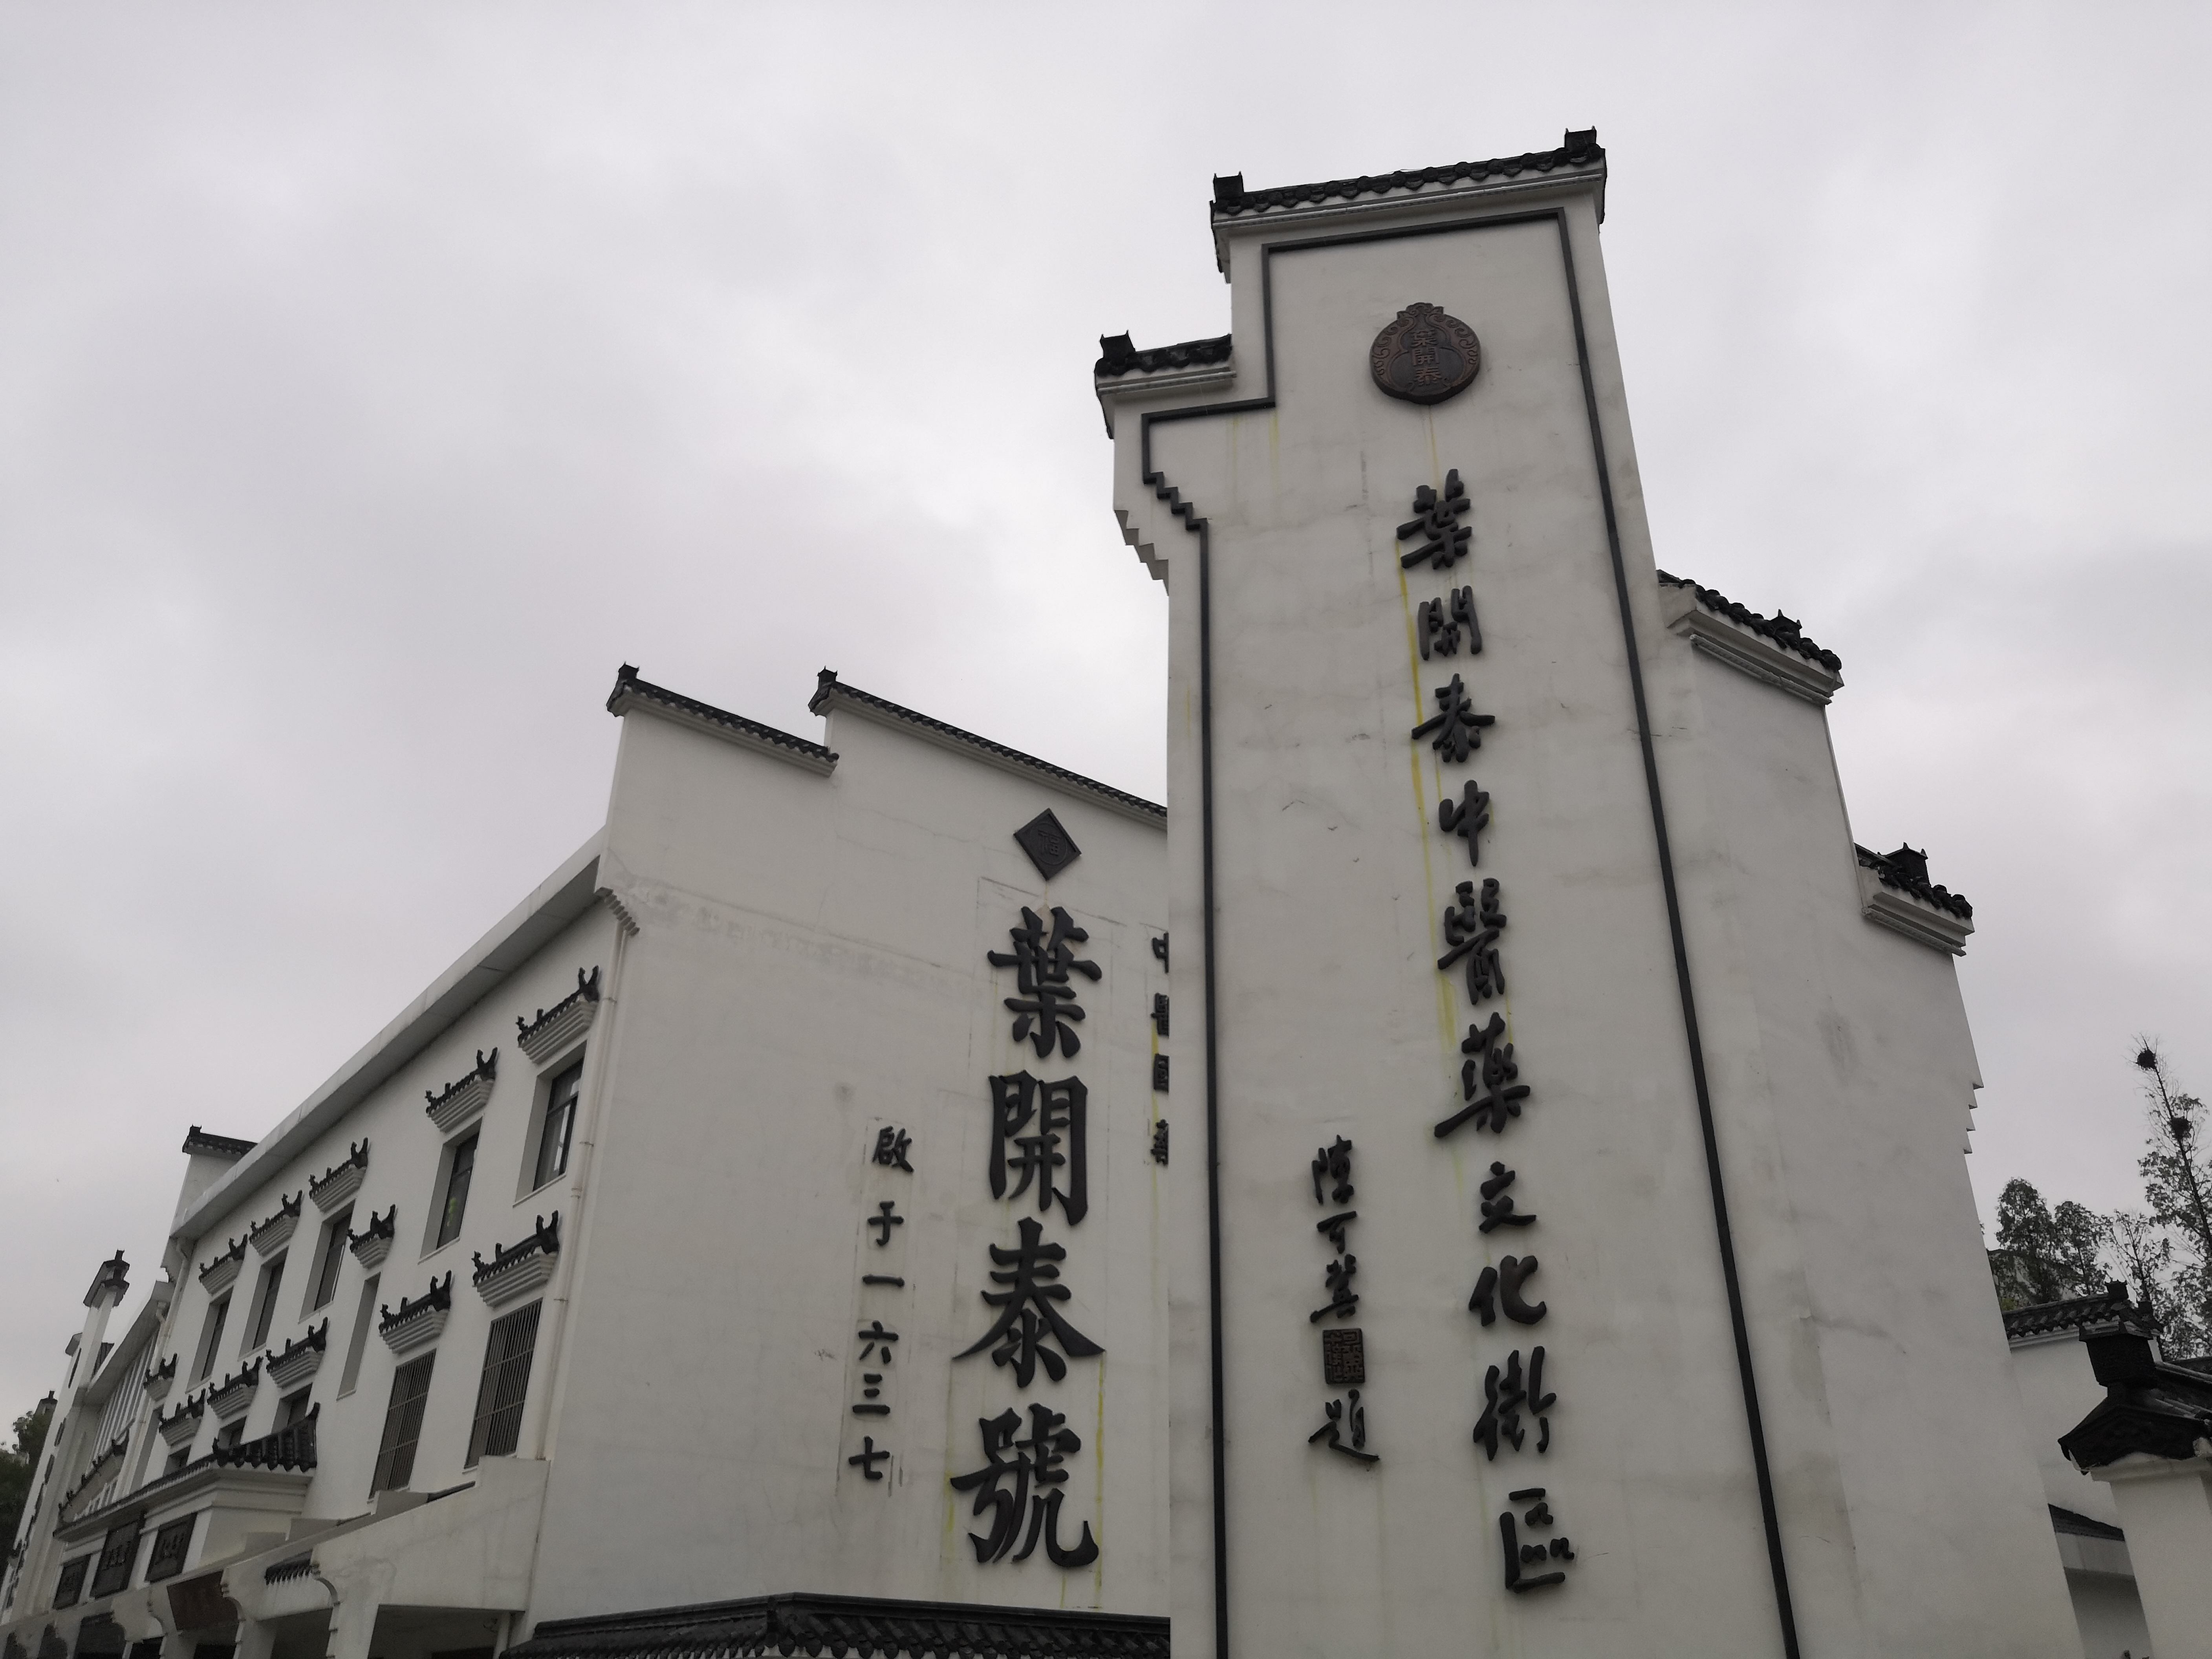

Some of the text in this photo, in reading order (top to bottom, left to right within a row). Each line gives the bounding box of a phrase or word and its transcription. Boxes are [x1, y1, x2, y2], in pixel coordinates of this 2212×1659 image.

[1409, 329, 1443, 387] 葉開泰
[949, 906, 1105, 1572] 葉開泰號
